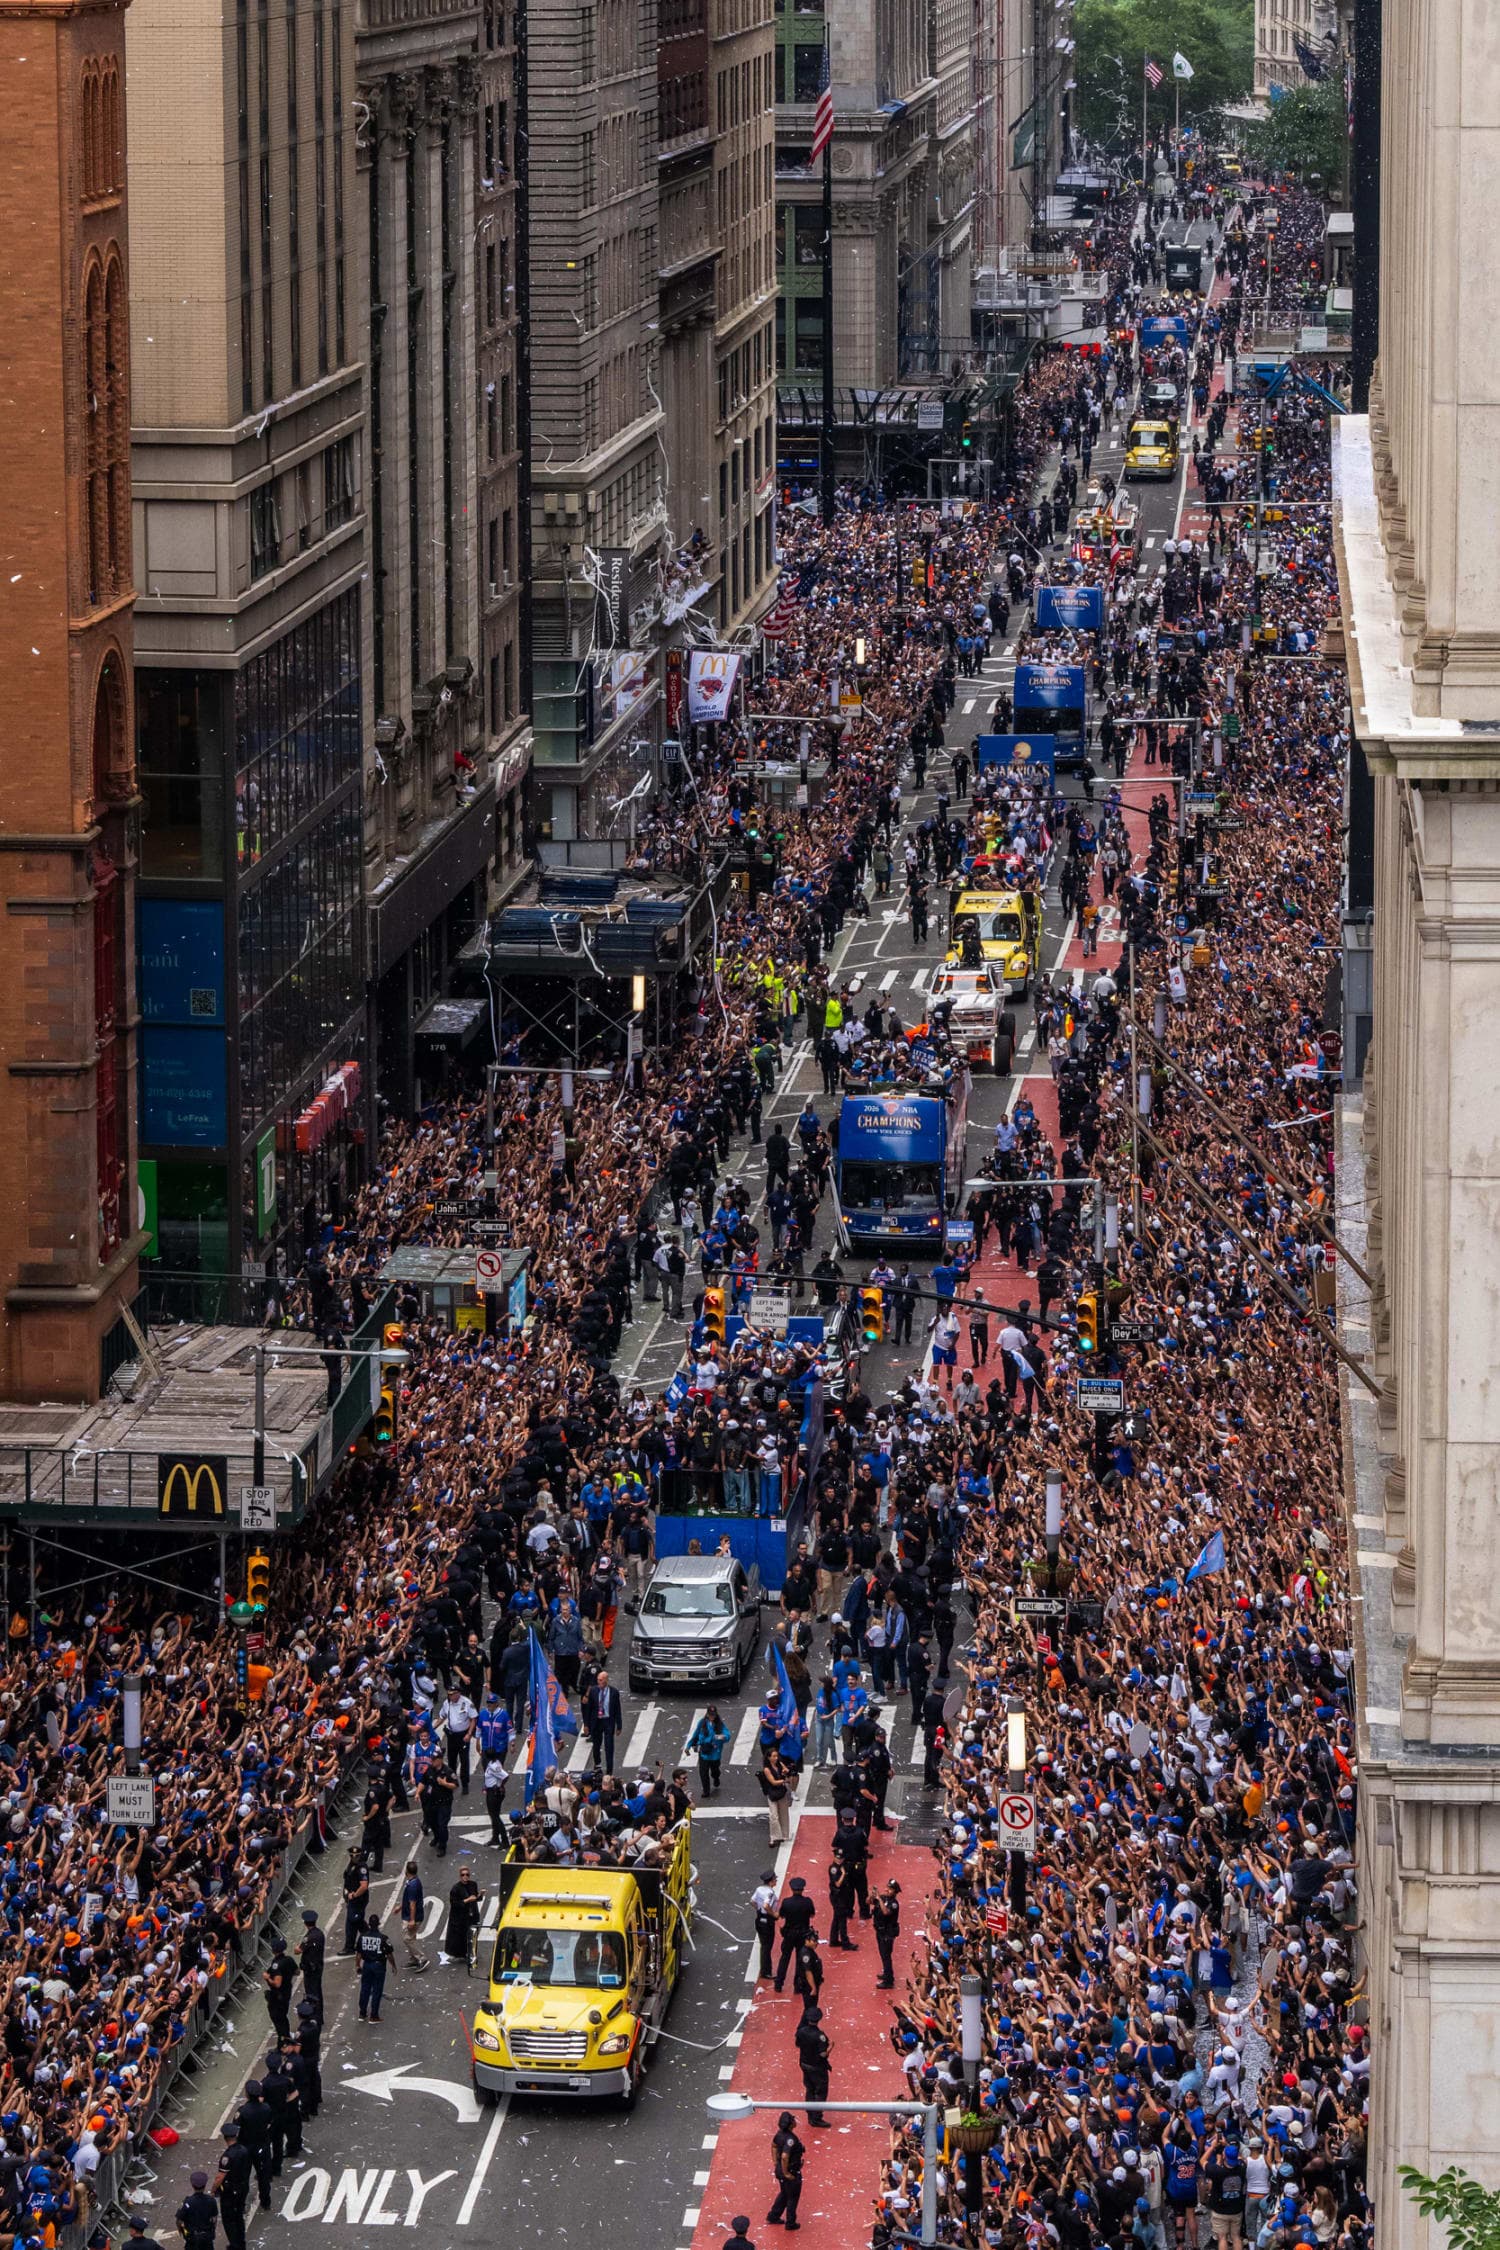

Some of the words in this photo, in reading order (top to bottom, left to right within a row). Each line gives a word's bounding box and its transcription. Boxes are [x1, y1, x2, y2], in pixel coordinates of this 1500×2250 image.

[902, 1106, 918, 1114] NBA
[857, 1114, 922, 1130] CHAMPIONS
[439, 1204, 457, 1214] John
[1114, 1331, 1131, 1341] Dey
[246, 1490, 270, 1499] STOP
[243, 1518, 262, 1527] RED
[111, 1783, 128, 1791] LEFT
[131, 1784, 150, 1792] LANE
[119, 1796, 143, 1806] MUST
[111, 1810, 130, 1818] TURN
[134, 1811, 150, 1819] LEFT
[361, 1936, 382, 1944] NYPD
[279, 2166, 459, 2226] ONLY
